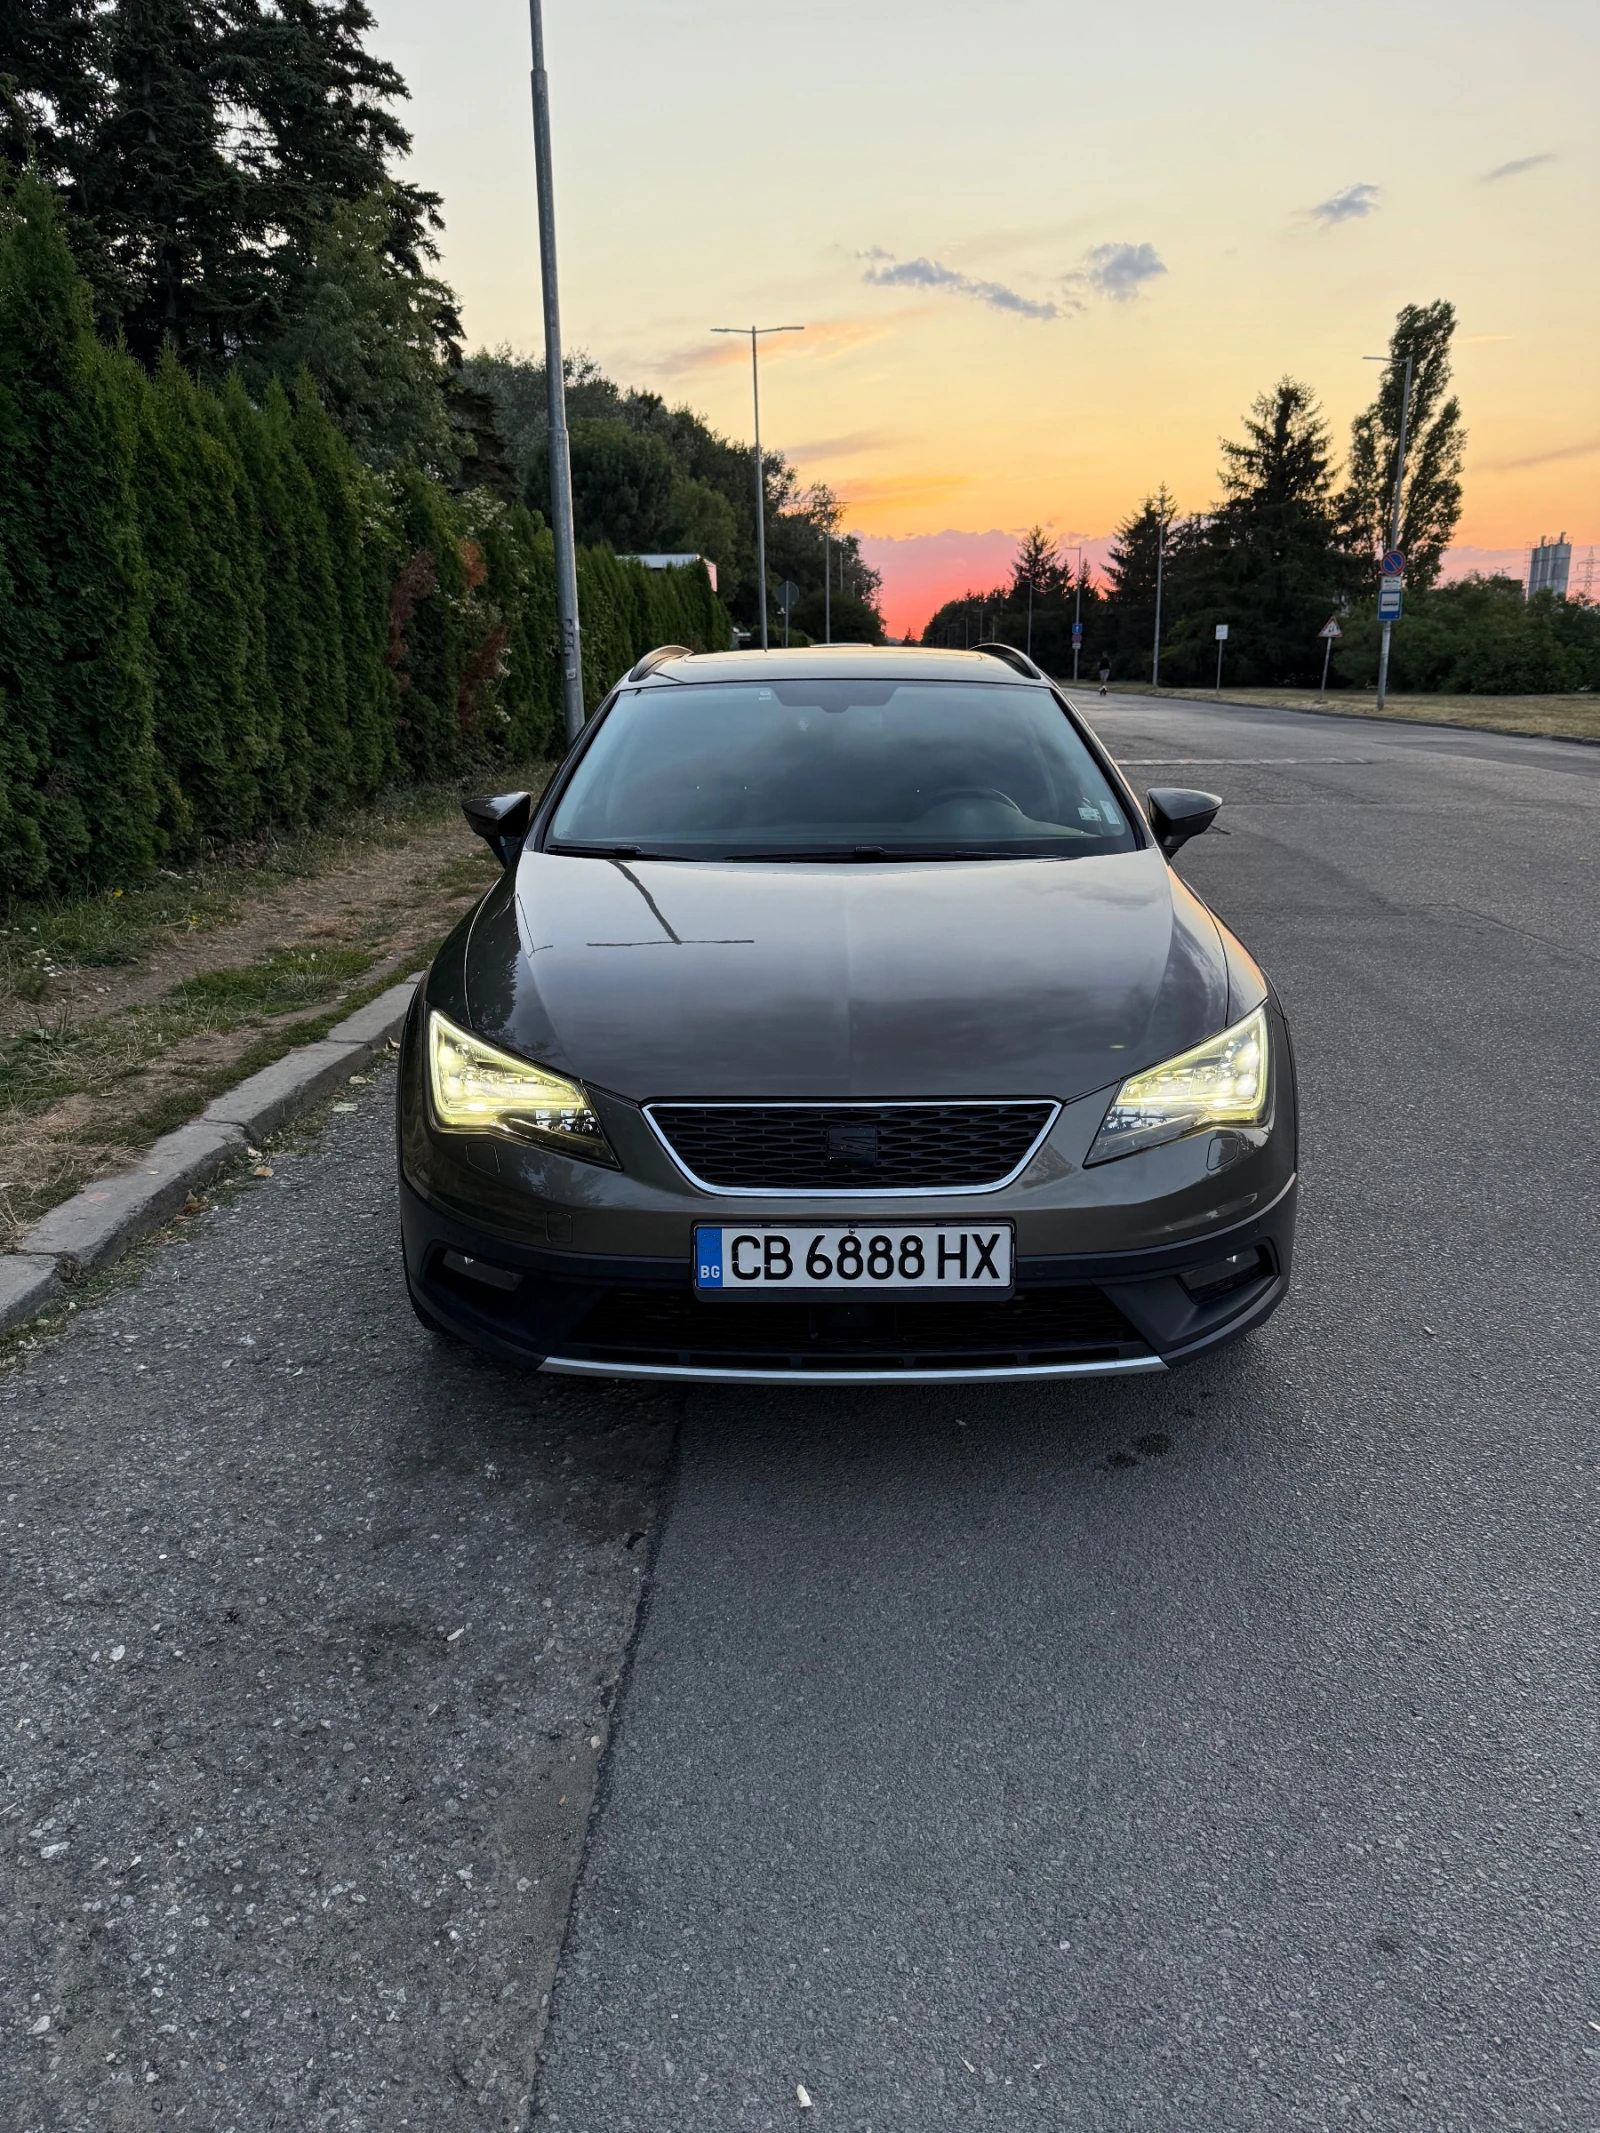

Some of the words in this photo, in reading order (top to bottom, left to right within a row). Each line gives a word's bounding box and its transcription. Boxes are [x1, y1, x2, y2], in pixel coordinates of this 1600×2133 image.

[731, 1234, 793, 1280] CB
[806, 1234, 925, 1280] 6888
[937, 1233, 1001, 1279] HX
[700, 1265, 720, 1279] BG
